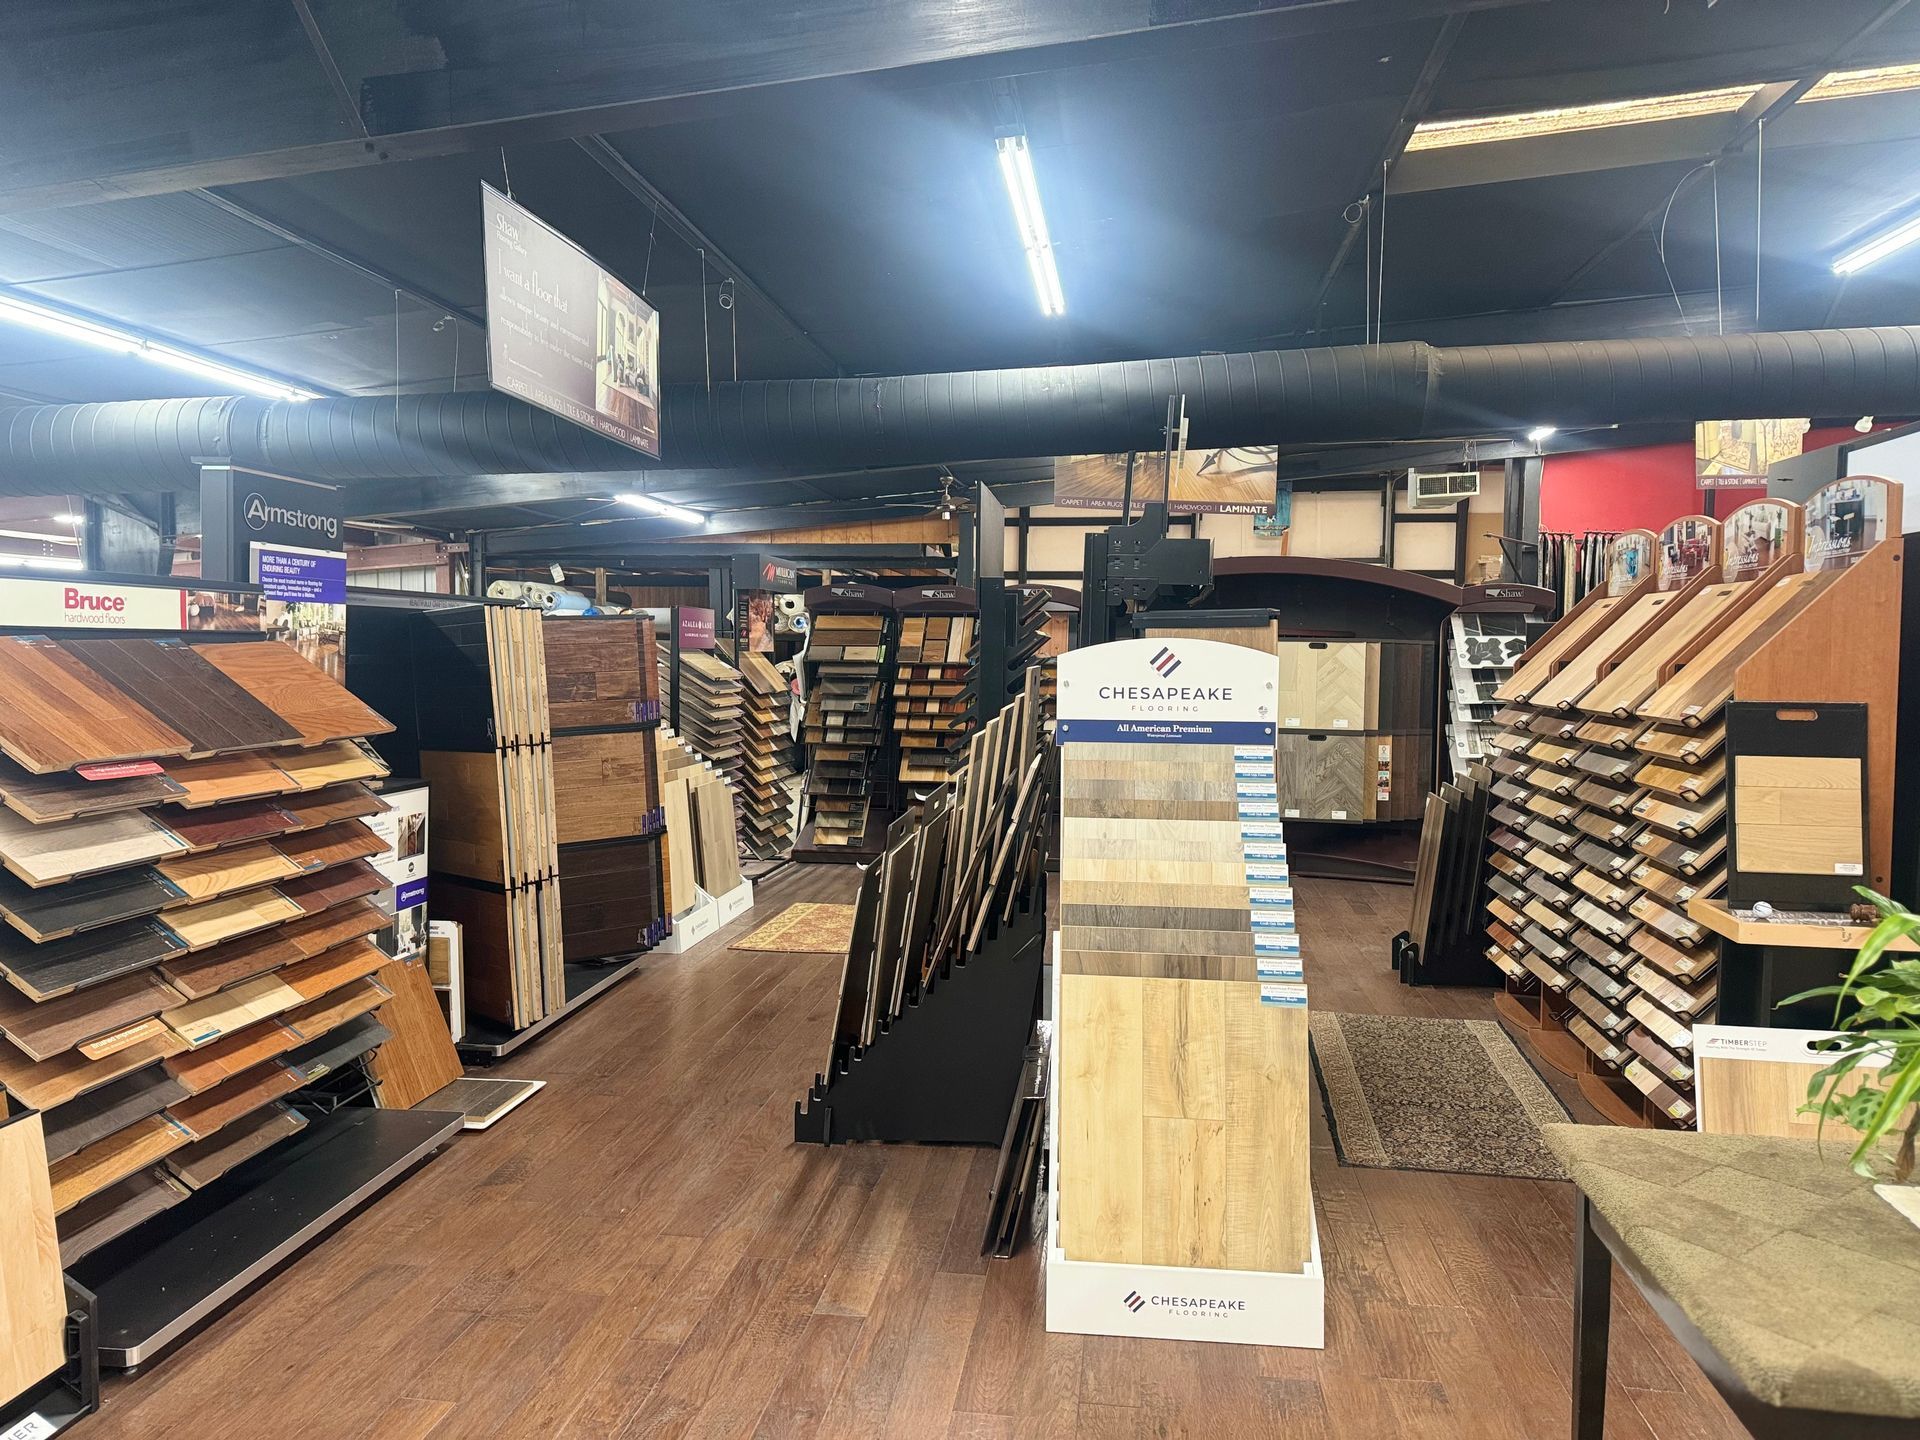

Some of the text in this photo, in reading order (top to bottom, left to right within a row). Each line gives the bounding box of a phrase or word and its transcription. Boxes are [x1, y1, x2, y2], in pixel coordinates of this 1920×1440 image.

[496, 213, 519, 241] Shaw
[503, 266, 523, 288] want
[524, 280, 530, 292] a
[532, 270, 553, 304] floor
[553, 283, 568, 313] that
[506, 376, 528, 393] CARPET
[580, 408, 596, 426] STONE
[599, 419, 626, 440] HARDWOOD
[630, 434, 650, 450] LAMINATE
[1061, 498, 1084, 506] CARPET
[1090, 500, 1106, 508] AREA
[1106, 500, 1123, 508] RUGS
[1219, 504, 1268, 514] LAMINATE
[246, 497, 337, 538] Armstrong
[262, 555, 275, 564] MORE
[275, 556, 287, 565] THAN
[292, 558, 310, 568] CENTURY
[311, 560, 316, 568] OF
[262, 564, 300, 575] ENDURING BEAUTY
[64, 588, 125, 611] Bruce
[844, 589, 864, 598] Shaw
[934, 590, 955, 598] Shaw
[1500, 588, 1523, 598] Shaw
[64, 612, 126, 624] hardwood floors
[682, 620, 698, 628] AZALEA
[1099, 686, 1232, 701] CHESAPEAKE
[1117, 724, 1213, 734] All American Premium
[400, 886, 425, 902] Armstrong
[1720, 1038, 1767, 1047] TIMBERSTEP
[1151, 1295, 1246, 1311] CHESAPEAKE
[1168, 1309, 1229, 1318] FLOORING
